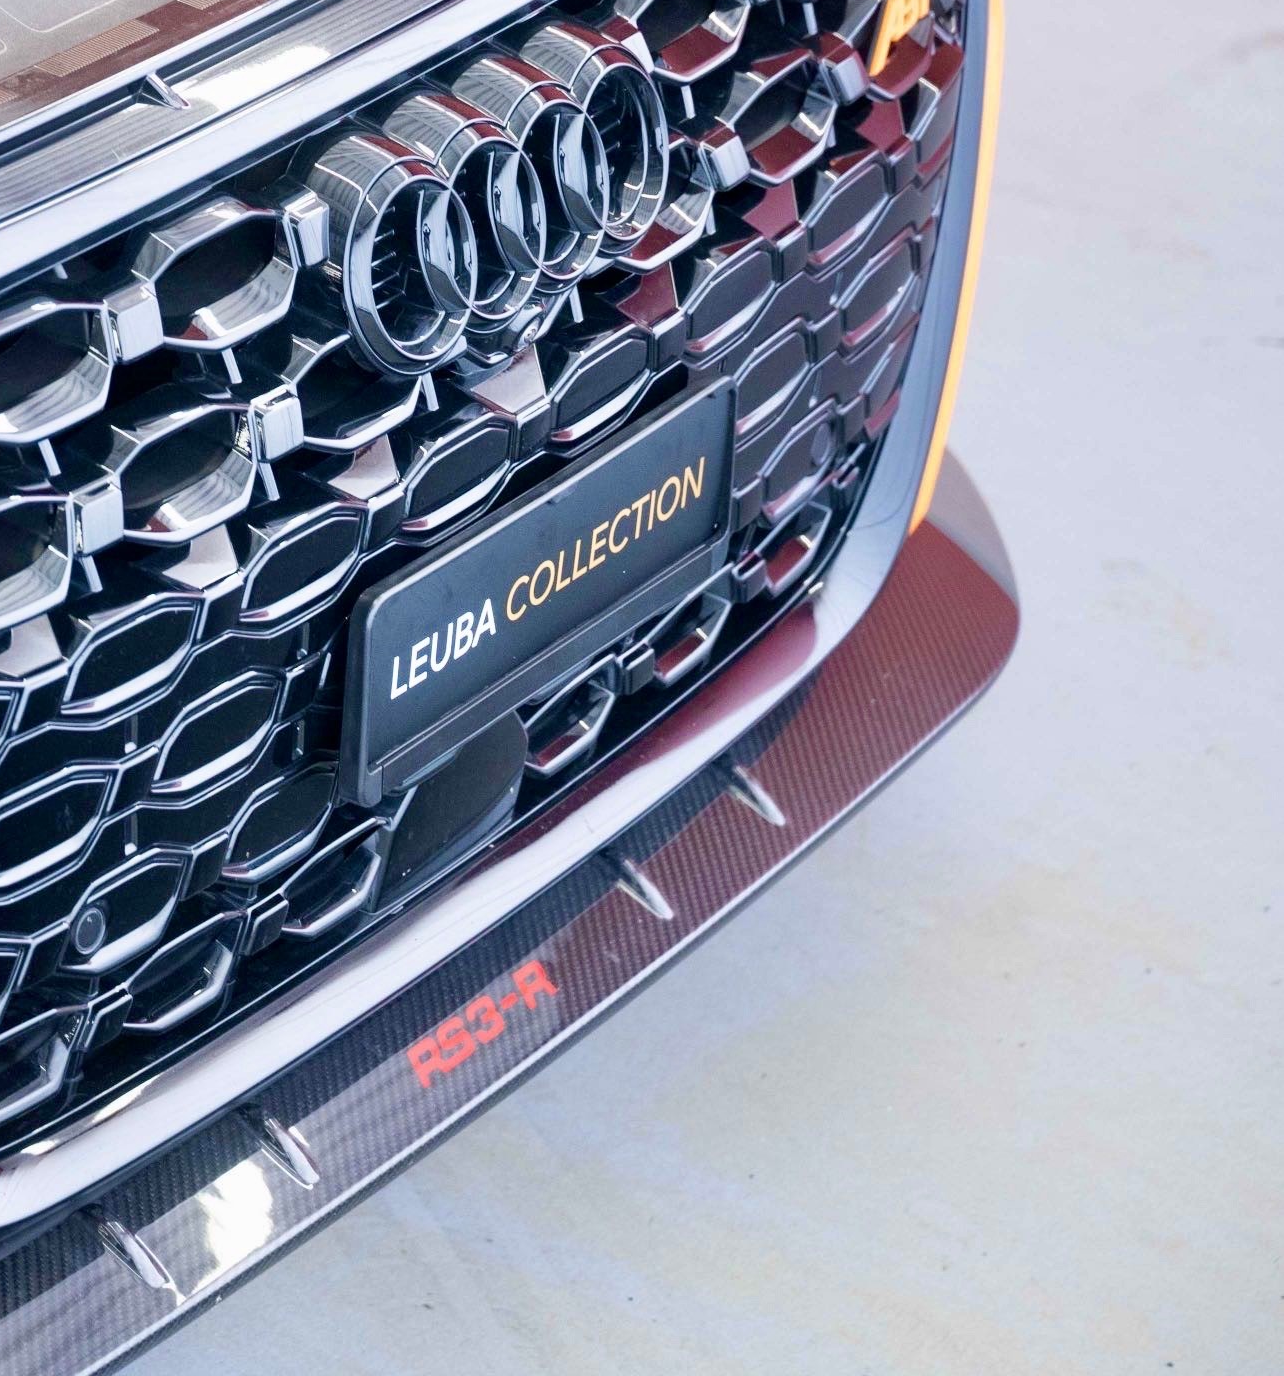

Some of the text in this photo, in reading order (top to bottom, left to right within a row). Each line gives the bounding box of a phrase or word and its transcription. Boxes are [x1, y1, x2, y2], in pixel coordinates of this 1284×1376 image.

[390, 456, 706, 701] LEUBA COLLECTION
[406, 959, 559, 1089] RS3-R
